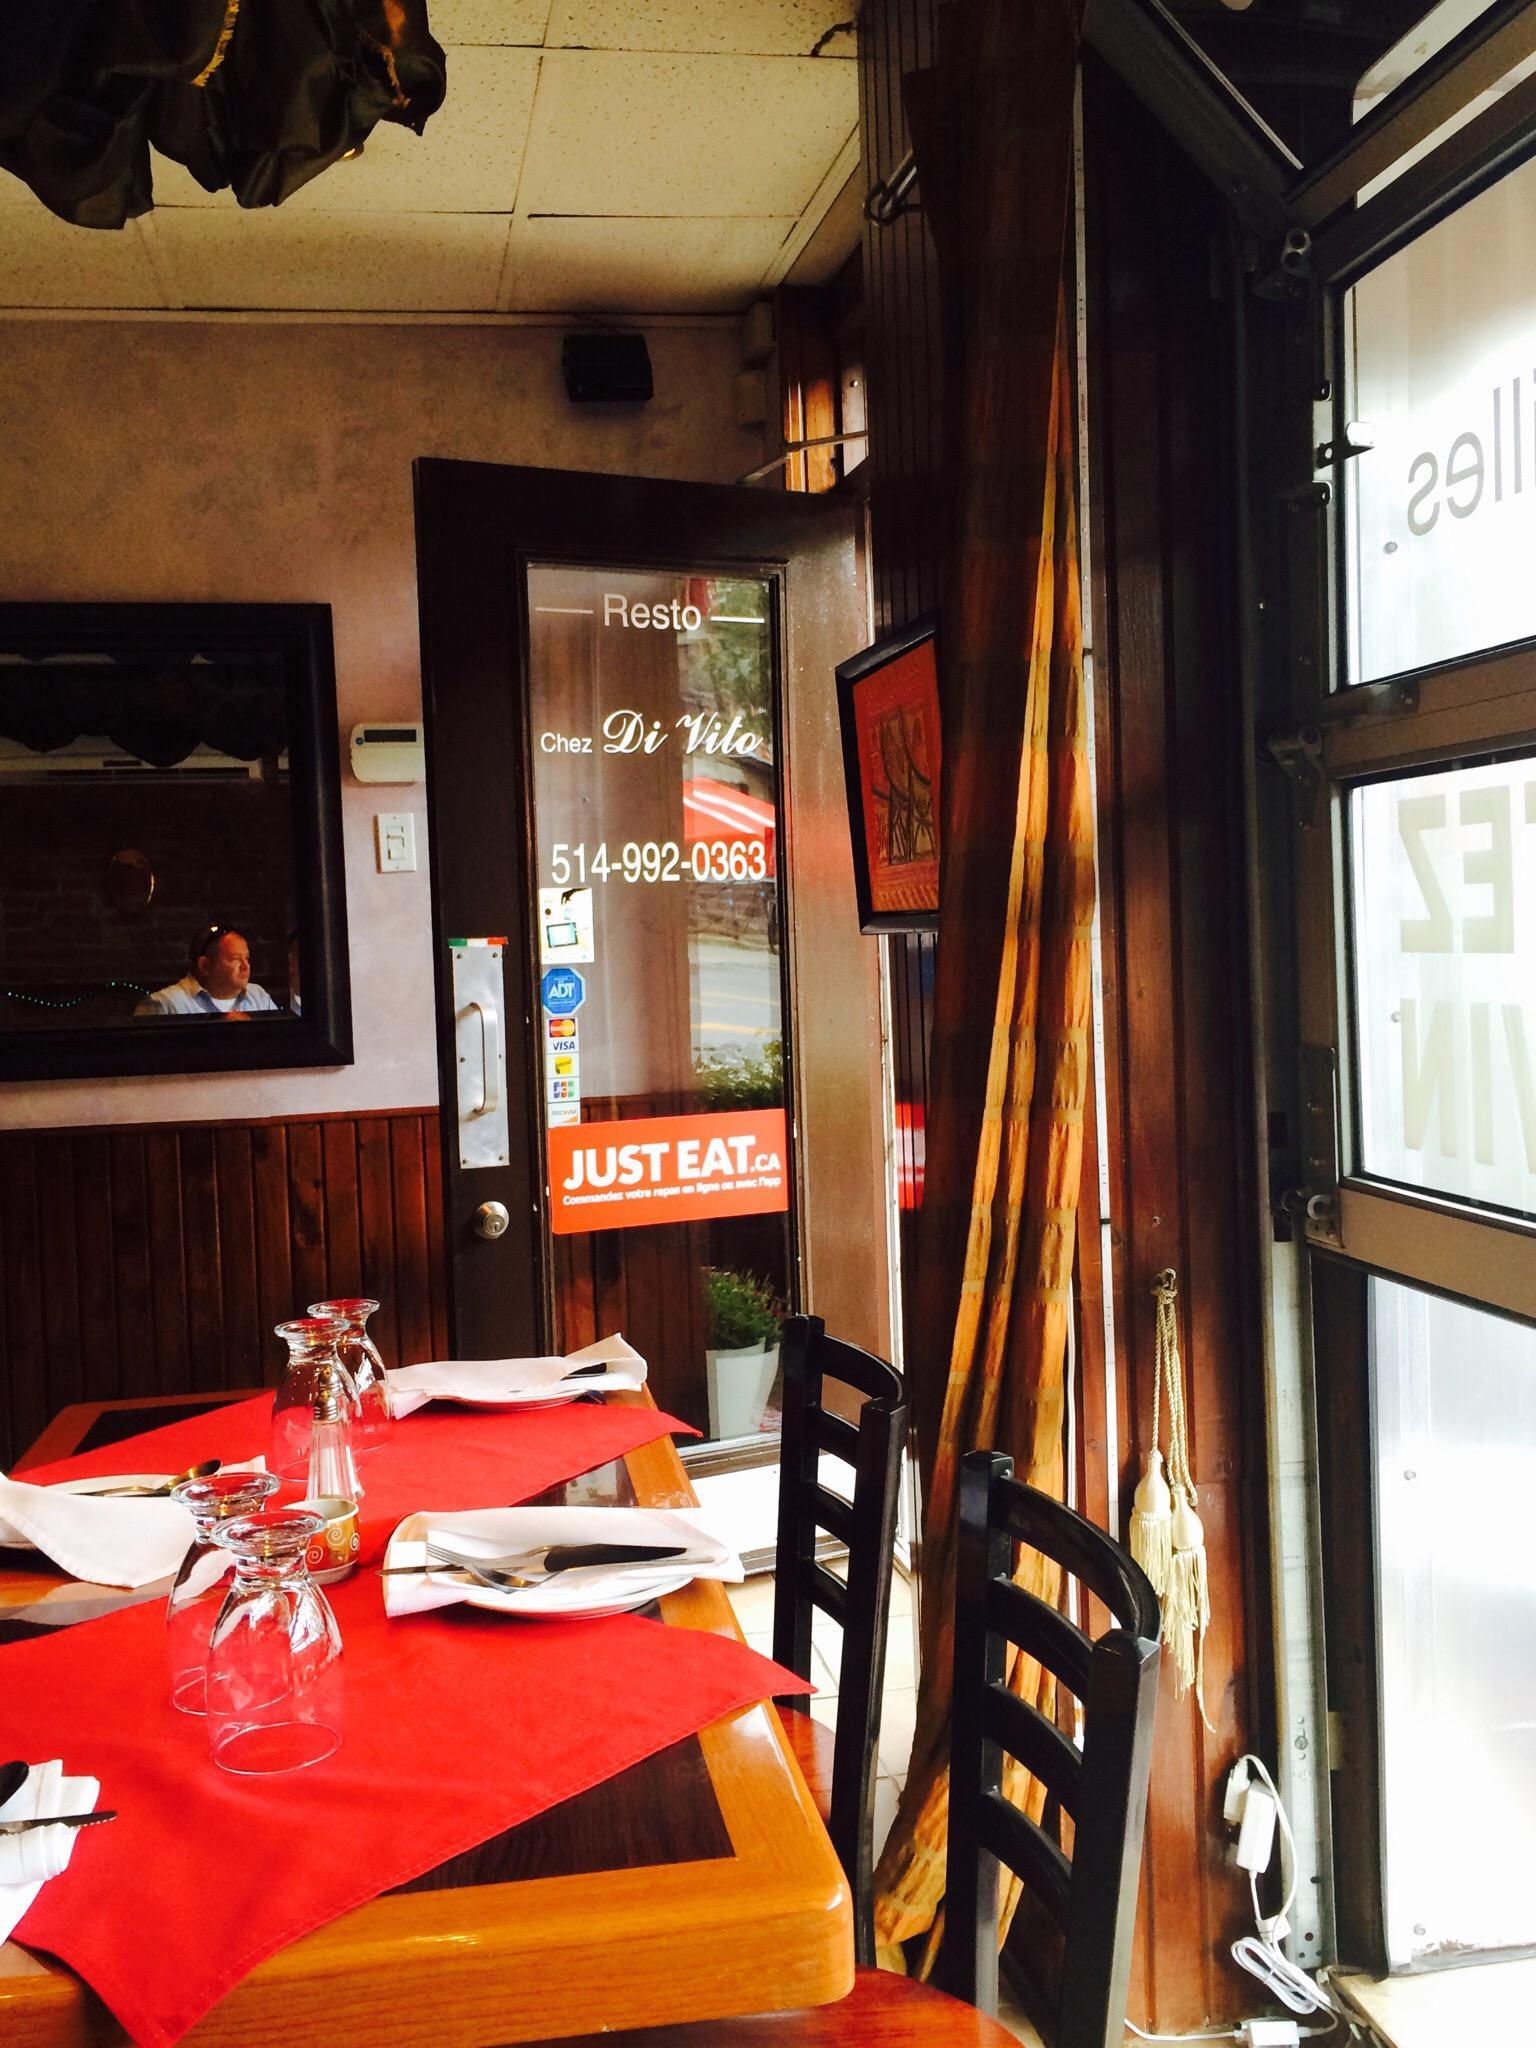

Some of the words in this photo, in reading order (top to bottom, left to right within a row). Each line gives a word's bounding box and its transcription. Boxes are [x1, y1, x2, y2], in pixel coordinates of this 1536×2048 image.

[603, 593, 702, 631] Resto
[540, 732, 592, 753] Chez
[602, 709, 669, 755] Di
[675, 711, 764, 755] Vito
[551, 841, 766, 884] 514-992-0363
[547, 982, 576, 999] ADT
[553, 1041, 576, 1051] VISA
[562, 1142, 670, 1190] JUST
[562, 1190, 624, 1206] Commandez
[625, 1188, 652, 1200] votre
[653, 1185, 681, 1197] repas
[682, 1184, 695, 1194] en
[696, 1181, 720, 1195] ligne
[721, 1180, 734, 1190] ou
[735, 1178, 758, 1189] avec
